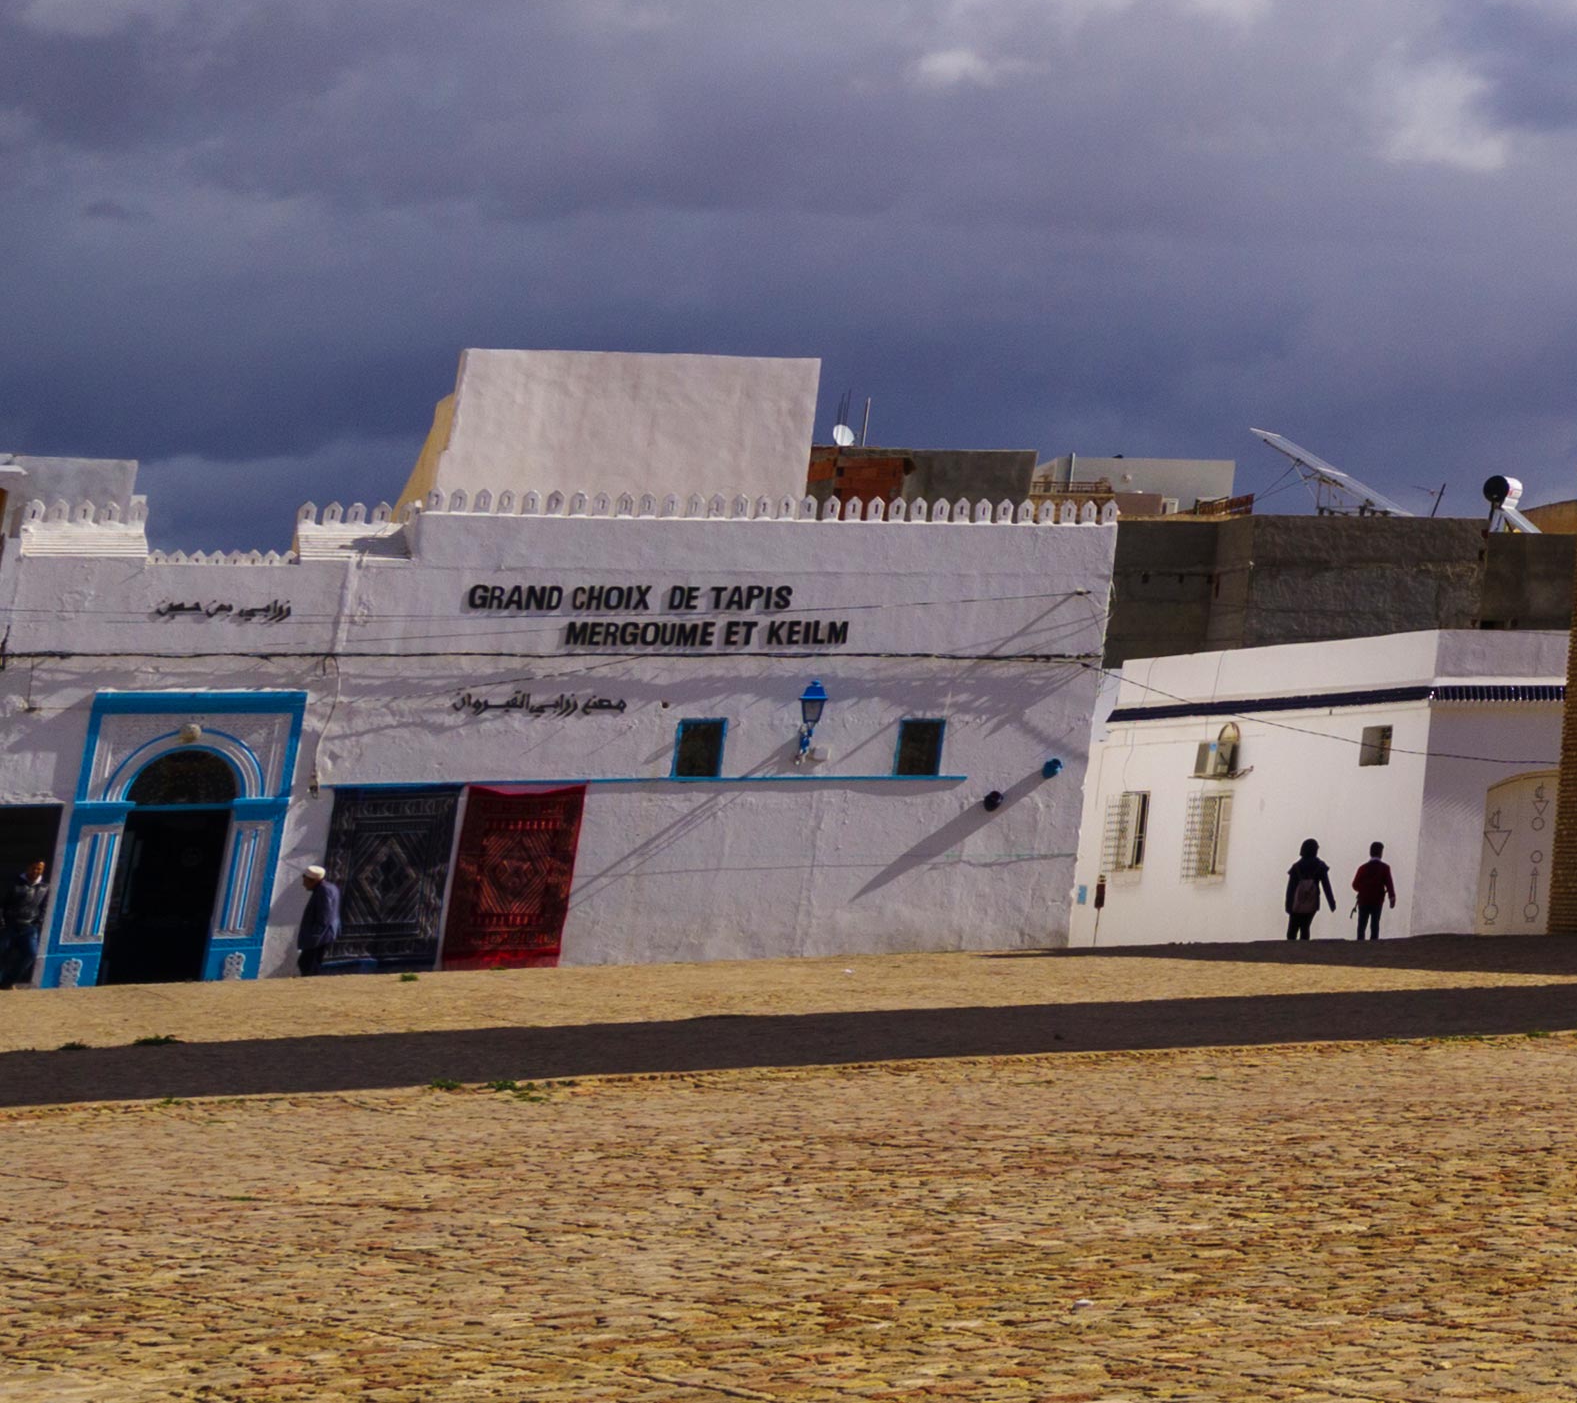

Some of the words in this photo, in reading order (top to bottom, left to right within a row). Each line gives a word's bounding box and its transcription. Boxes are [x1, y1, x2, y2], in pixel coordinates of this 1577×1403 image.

[468, 584, 564, 610] GRAND
[571, 585, 652, 610] CHOIX
[668, 585, 700, 610] DE
[711, 585, 793, 610] TAPIS
[239, 599, 291, 622] زرابي
[565, 621, 716, 646] MERGOUME
[724, 621, 758, 646] ET
[766, 620, 849, 645] KEILM
[452, 691, 530, 716] القيروان
[529, 693, 578, 718] زرابي
